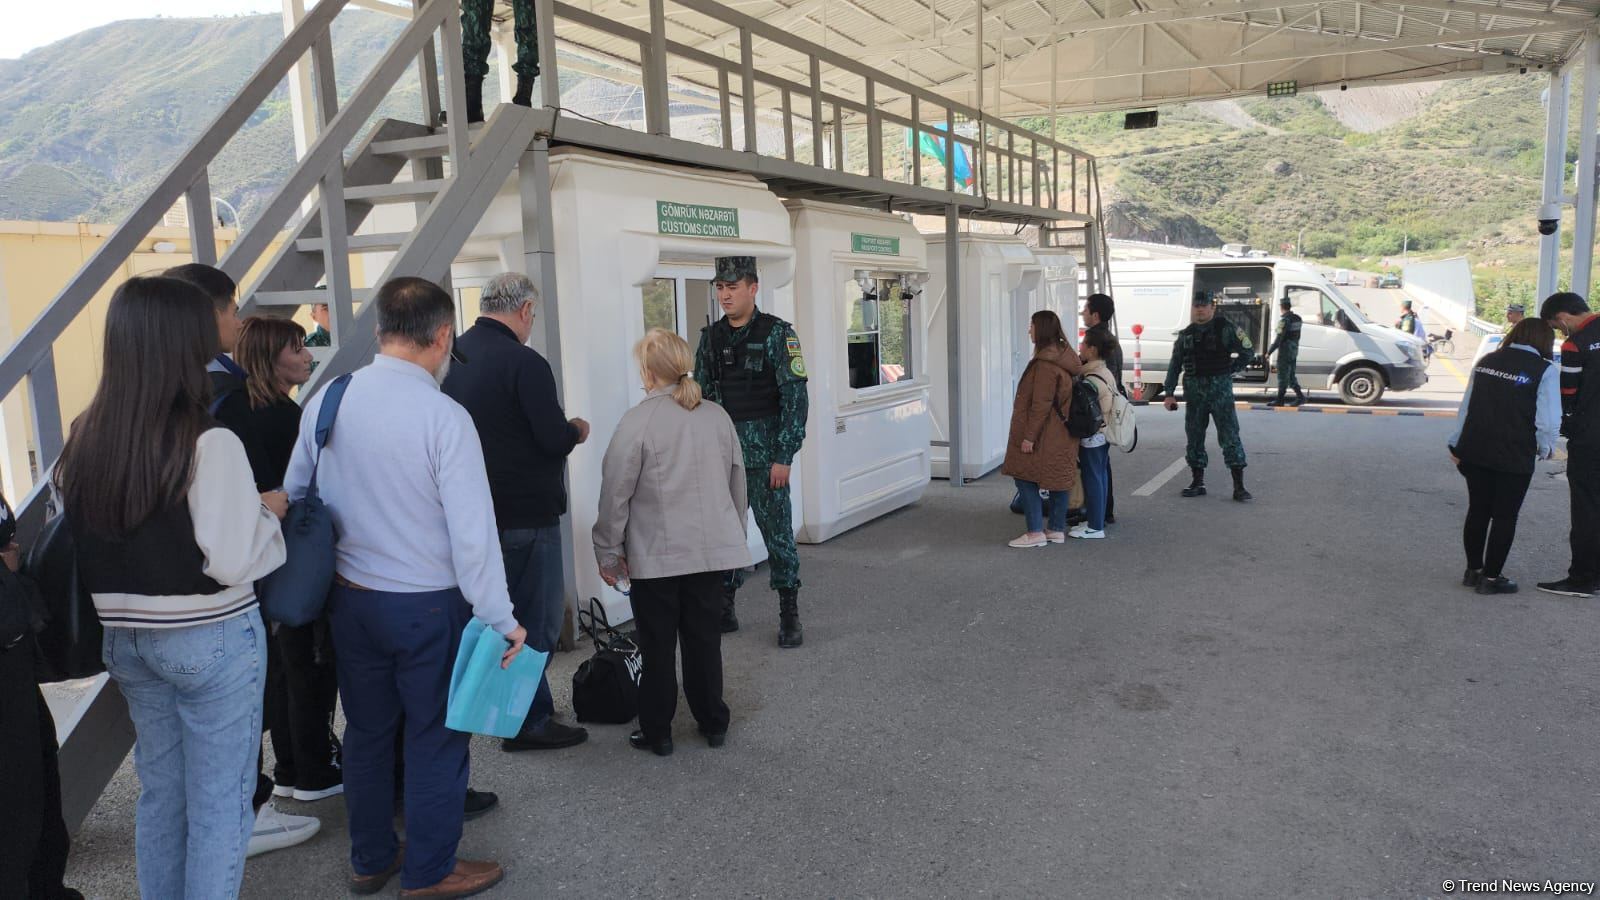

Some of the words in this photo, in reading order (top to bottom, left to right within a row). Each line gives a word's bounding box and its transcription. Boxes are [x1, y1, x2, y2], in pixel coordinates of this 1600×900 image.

[661, 203, 697, 219] GÖMRÜK
[699, 208, 735, 222] NƏZARƏTİ
[661, 220, 701, 234] CUSTOMS
[703, 224, 738, 236] CONTROL
